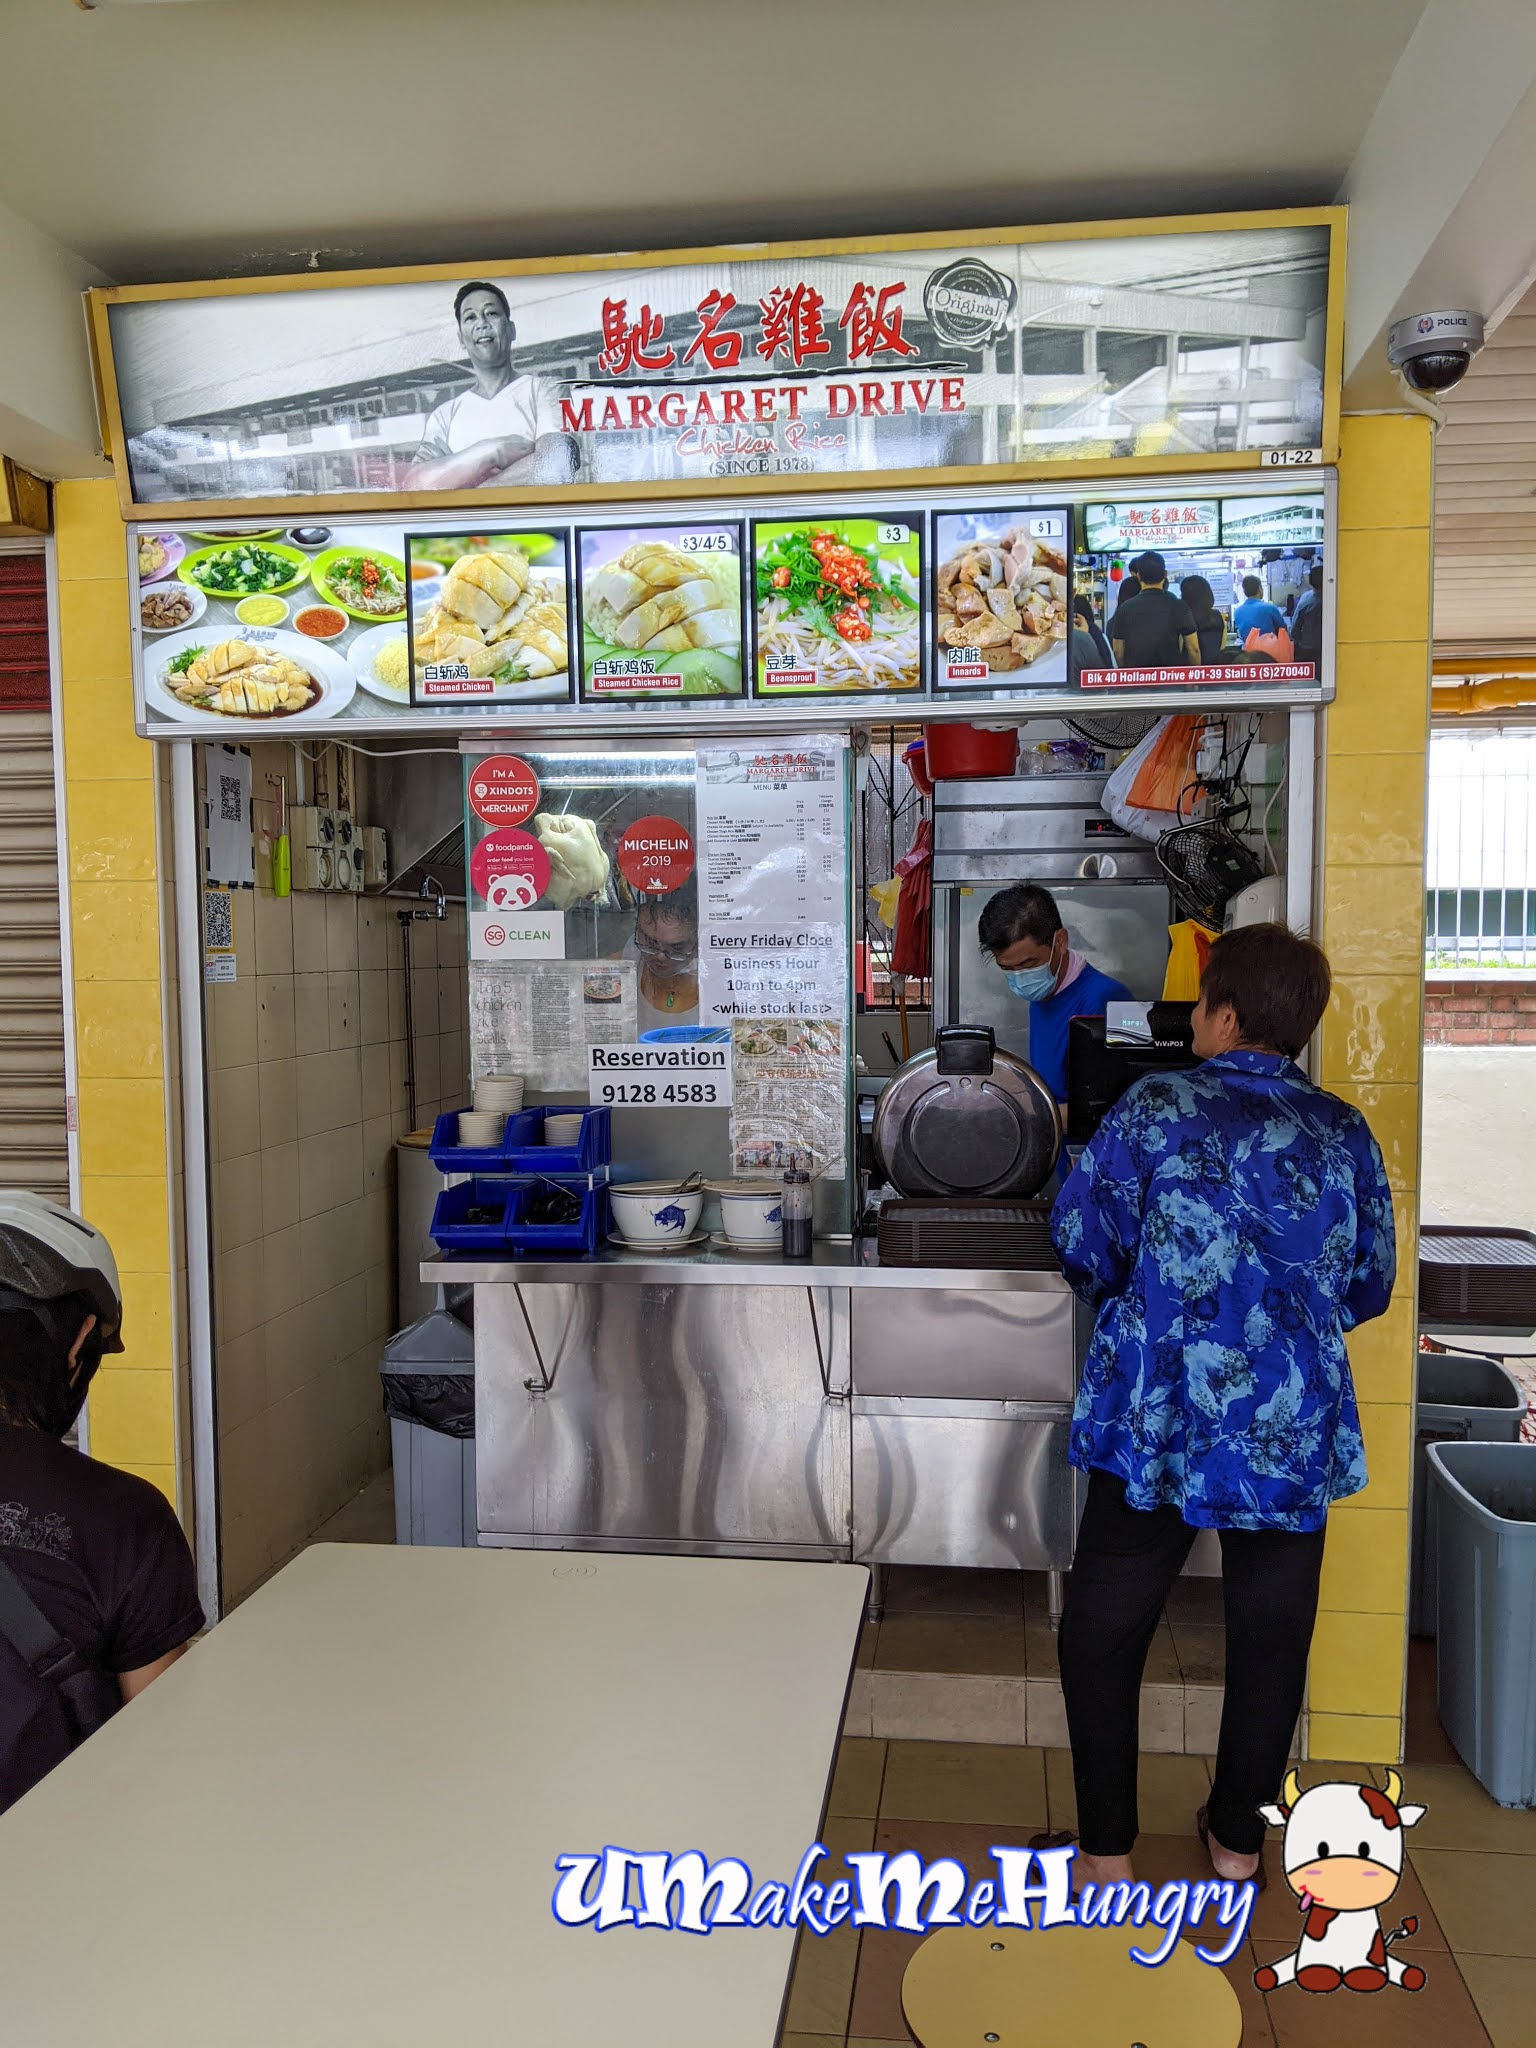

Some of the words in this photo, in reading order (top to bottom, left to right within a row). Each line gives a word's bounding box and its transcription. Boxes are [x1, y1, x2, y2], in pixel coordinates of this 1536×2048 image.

[935, 288, 1000, 317] Original
[598, 281, 919, 376] 馳名雞飯
[1437, 318, 1468, 327] POLICE
[559, 386, 810, 433] MARGARET
[826, 376, 966, 421] DRIVE
[675, 427, 777, 458] Chicken
[786, 422, 848, 452] Rice
[1271, 450, 1313, 465] 01-22
[709, 458, 770, 476] (SINCE
[773, 455, 815, 475] 1978)
[886, 527, 901, 541] $3
[1038, 520, 1052, 535] $1
[1119, 526, 1175, 537] MARGARET
[1178, 525, 1210, 535] DRIVE
[683, 535, 727, 551] $3/4/5
[766, 653, 798, 670] 豆芽
[948, 647, 981, 663] 内脏
[424, 664, 469, 680] 白斩鸡
[594, 658, 656, 675] 白斩鸡饭
[952, 666, 982, 677] Innards
[770, 672, 813, 684] Beansprout
[1087, 673, 1103, 683] Blk
[1105, 672, 1117, 683] 40
[1119, 671, 1157, 682] Holland
[1159, 669, 1185, 681] Drive
[1188, 668, 1222, 680] #01-39
[1224, 667, 1248, 679] Stall
[1250, 667, 1256, 678] 5
[1259, 665, 1310, 679] (S)270040
[429, 682, 460, 693] Steamed
[461, 681, 490, 692] Chicken
[598, 678, 630, 689] Steamed
[631, 677, 660, 688] Chicken
[662, 676, 679, 687] Rice
[493, 769, 506, 778] I'M
[508, 769, 515, 778] A
[489, 786, 534, 795] XINDOTS
[773, 782, 788, 791] 菜单
[481, 804, 529, 813] MERCHANT
[495, 843, 533, 852] foodpanda
[624, 839, 689, 850] MICHELIN
[642, 855, 671, 866] 2019
[487, 931, 503, 940] SG
[509, 930, 551, 940] CLEAN
[710, 934, 747, 947] Every
[751, 934, 792, 947] Friday
[796, 933, 833, 946] Close
[724, 958, 781, 969] Business
[786, 957, 819, 969] Hour
[476, 980, 501, 997] Top
[504, 980, 512, 994] 5
[727, 980, 764, 991] 10am
[768, 980, 782, 991] to
[786, 980, 816, 993] 4pm
[476, 997, 522, 1011] chicken
[712, 1001, 757, 1013] <while
[760, 1002, 796, 1013] stock
[800, 1001, 832, 1013] last>
[592, 1046, 725, 1066] Reservation
[602, 1084, 657, 1103] 9128
[662, 1084, 717, 1103] 4583
